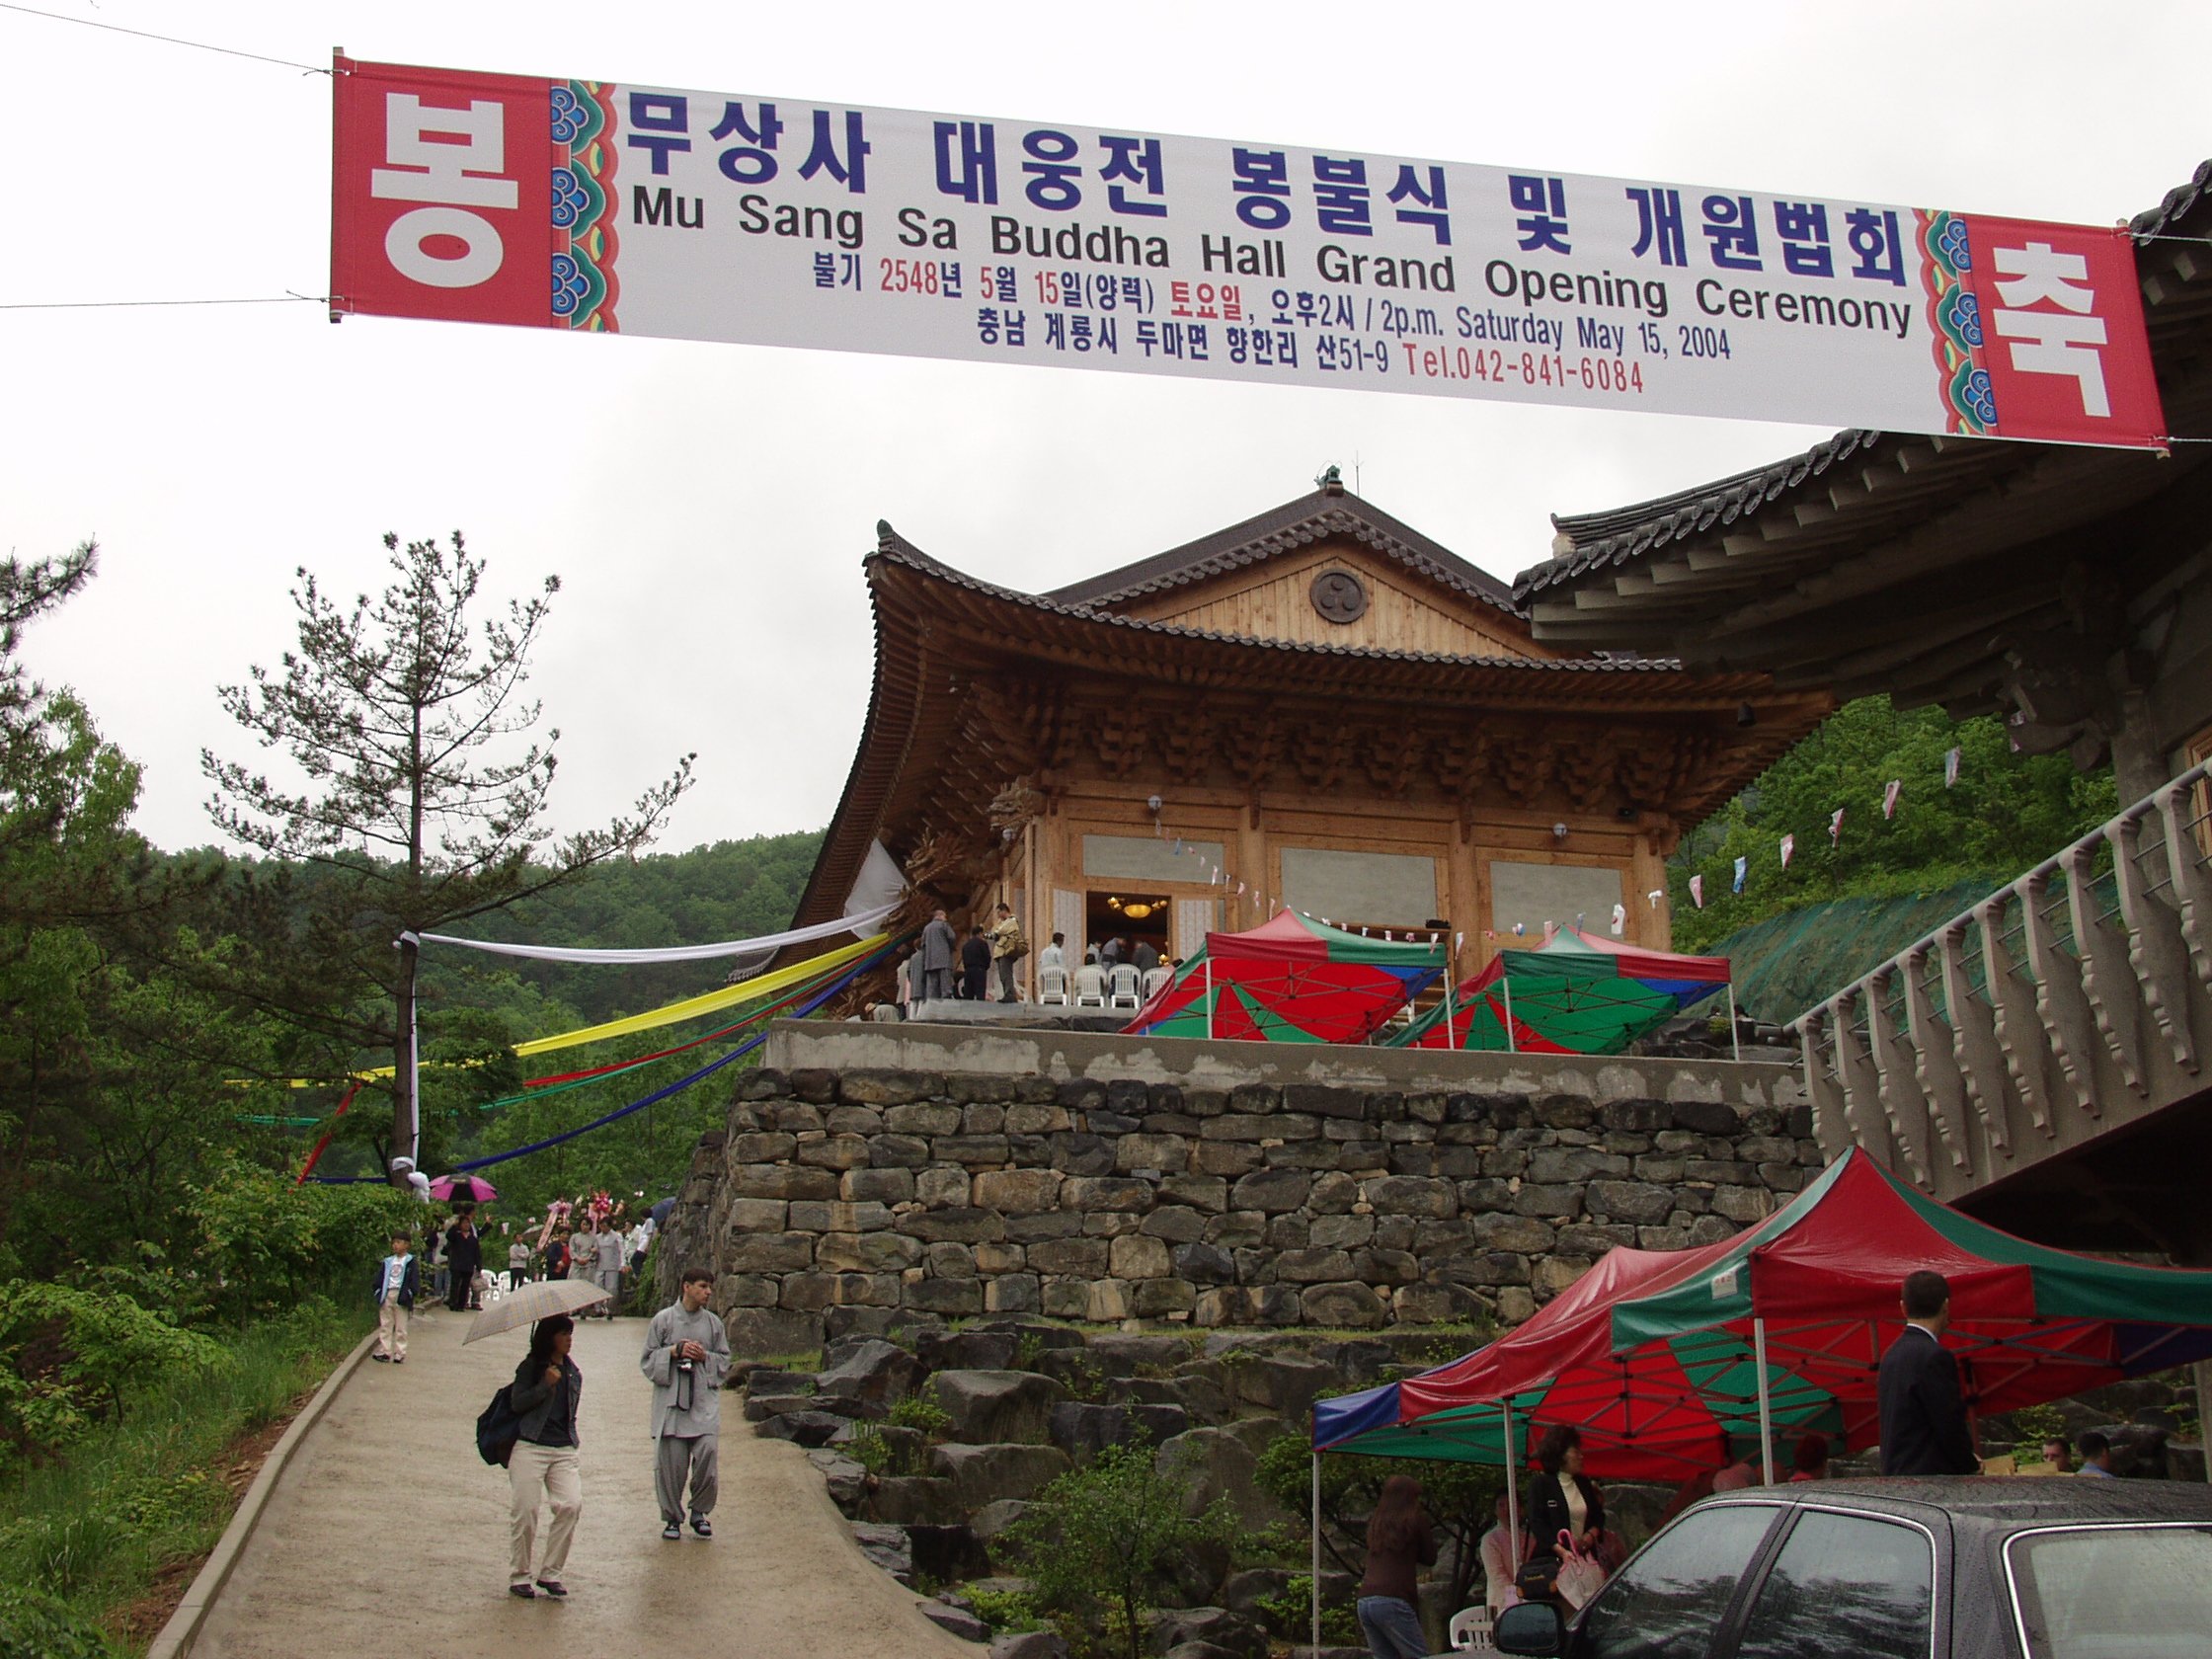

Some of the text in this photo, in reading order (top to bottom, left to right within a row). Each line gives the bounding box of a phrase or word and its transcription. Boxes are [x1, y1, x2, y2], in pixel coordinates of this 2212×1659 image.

[370, 91, 518, 288] 봉
[628, 92, 1907, 287] 무상사 대웅전 봉불식 및 개원법회
[633, 185, 1912, 340] Mu Sang Sa Buddha Hall Grand Opening Ceremony
[814, 252, 862, 292] 불기
[880, 258, 963, 299] 2548년
[980, 266, 1018, 303] 5월
[1034, 272, 1154, 315] 15일(양력)
[1271, 289, 1355, 332] 오후2시
[1381, 300, 1444, 340] 2p.m.
[1456, 306, 1563, 353] Saturday
[1576, 317, 1624, 357] May
[1637, 322, 1669, 360] 15,
[1678, 326, 1731, 360] 2004
[977, 307, 1643, 394] 충남 계룡시 두마면 향한리 산51-9 Tel.042-841-6084
[1993, 242, 2111, 419] 축
